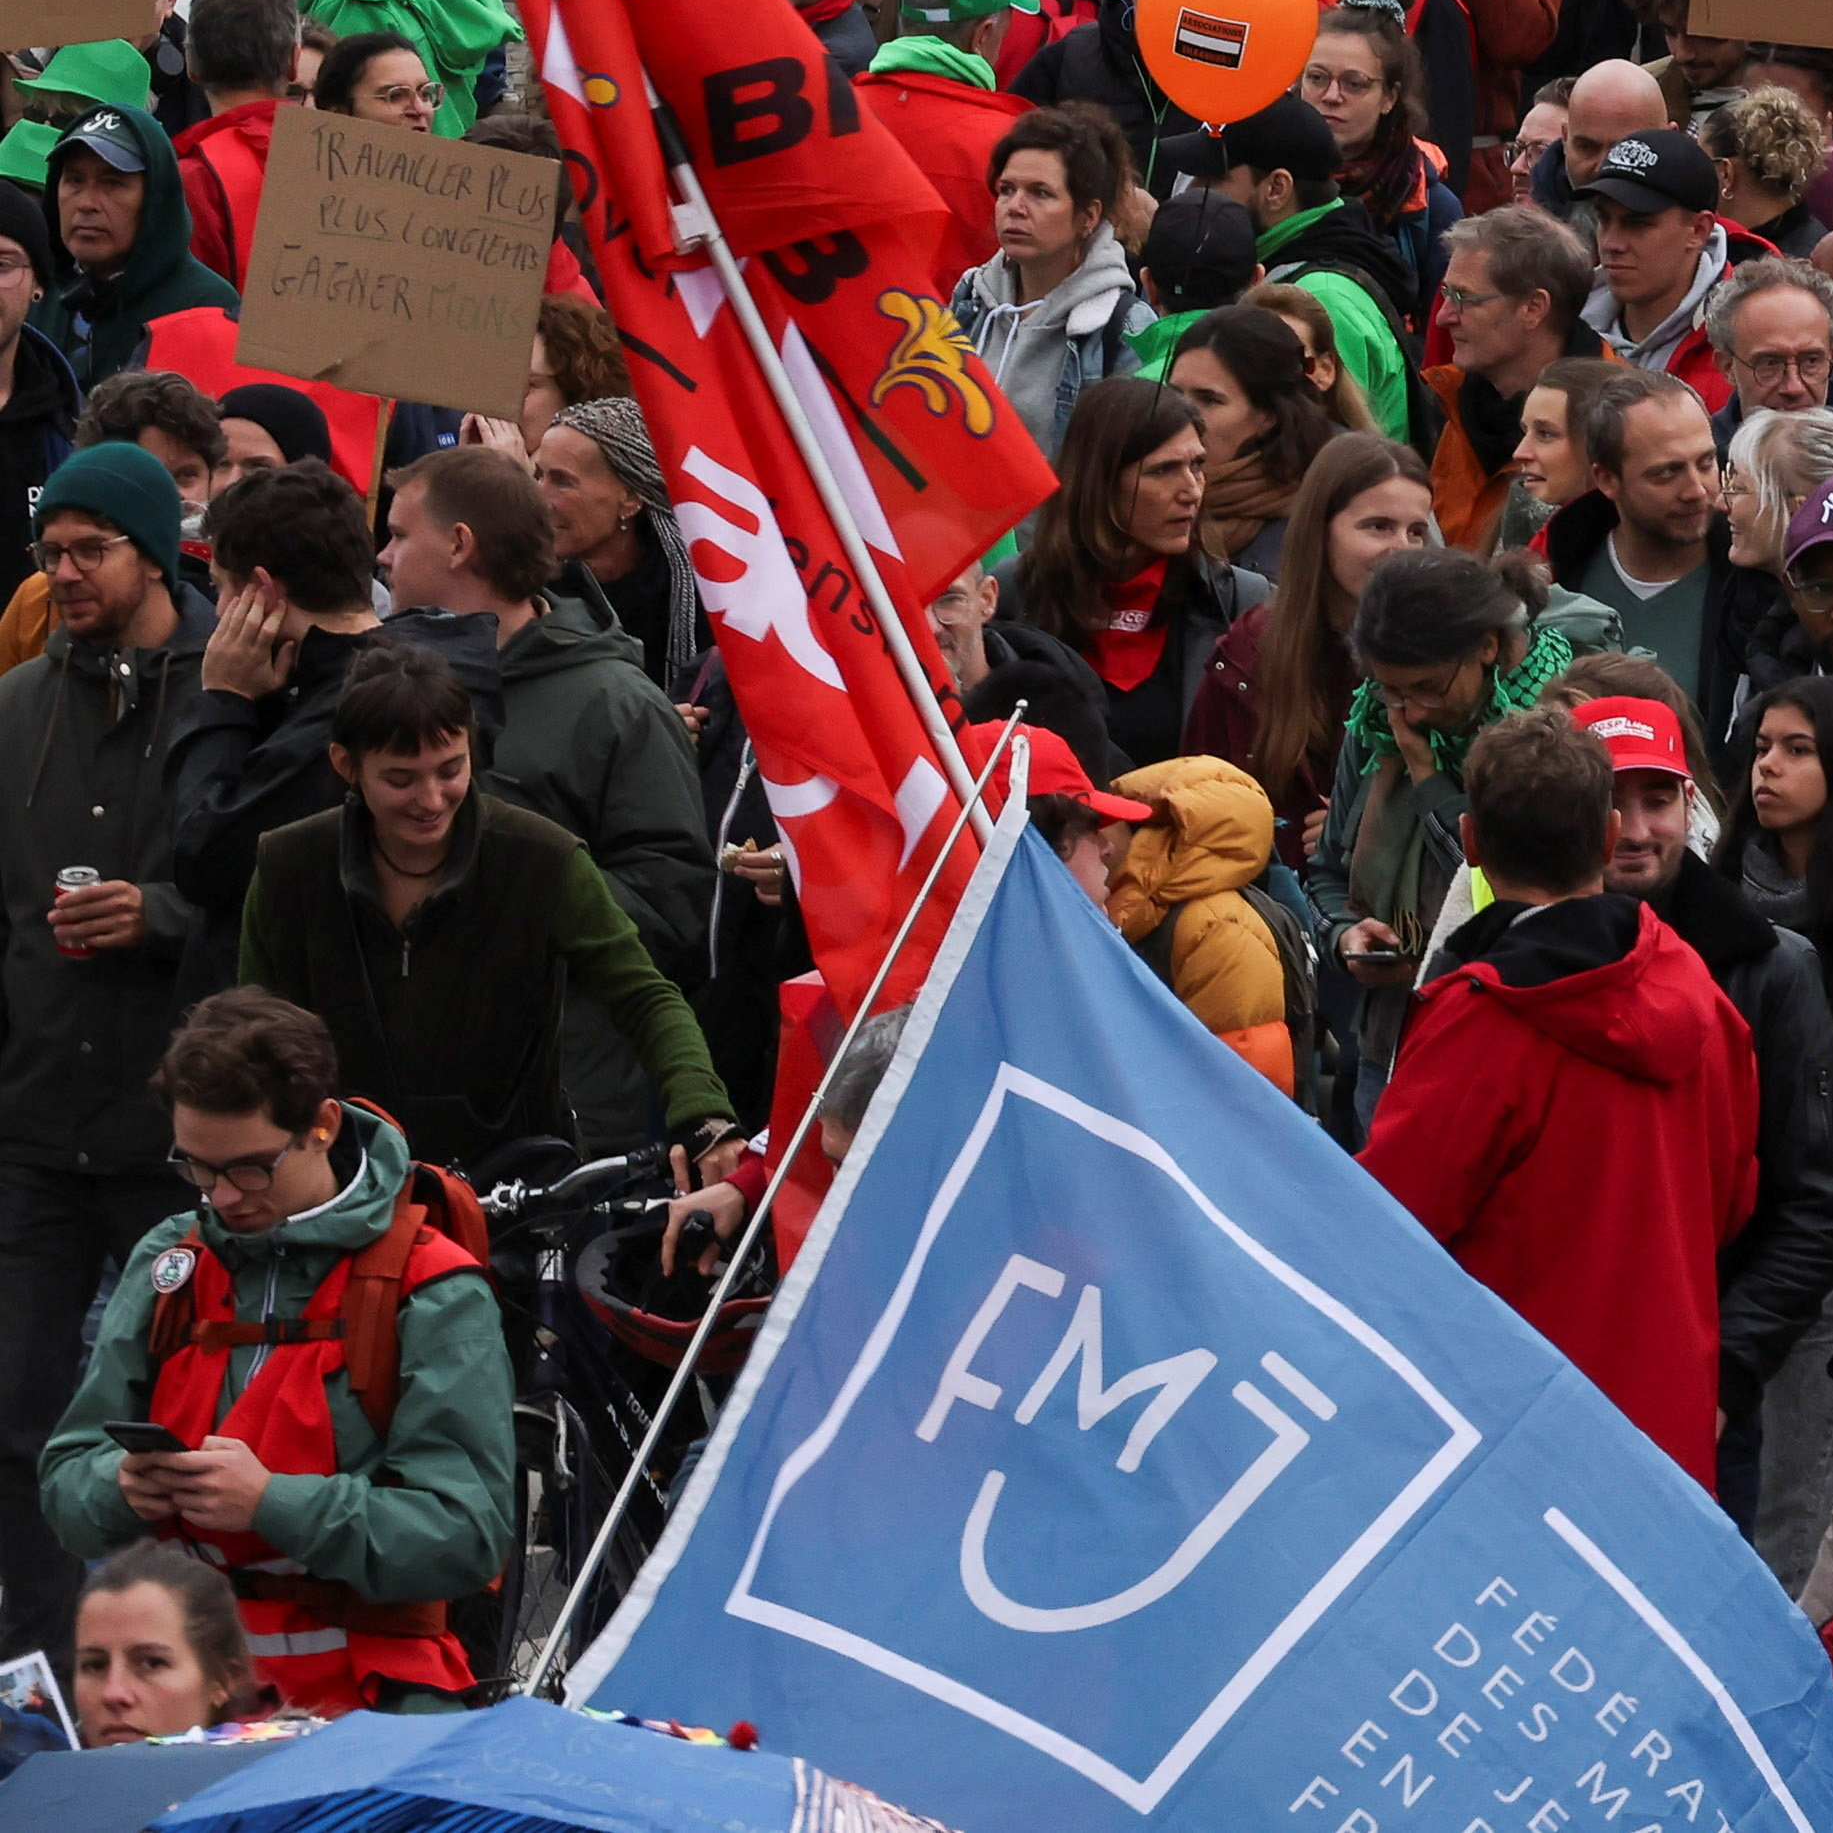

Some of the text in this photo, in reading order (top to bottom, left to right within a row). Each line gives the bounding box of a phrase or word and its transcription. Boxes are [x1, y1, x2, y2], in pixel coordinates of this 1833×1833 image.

[312, 122, 551, 223] TRAVAILLER PLUS
[319, 194, 389, 236] PLUS
[271, 243, 412, 321] GAGNER
[1388, 1668, 1483, 1759] DE
[1432, 1622, 1560, 1743] DES
